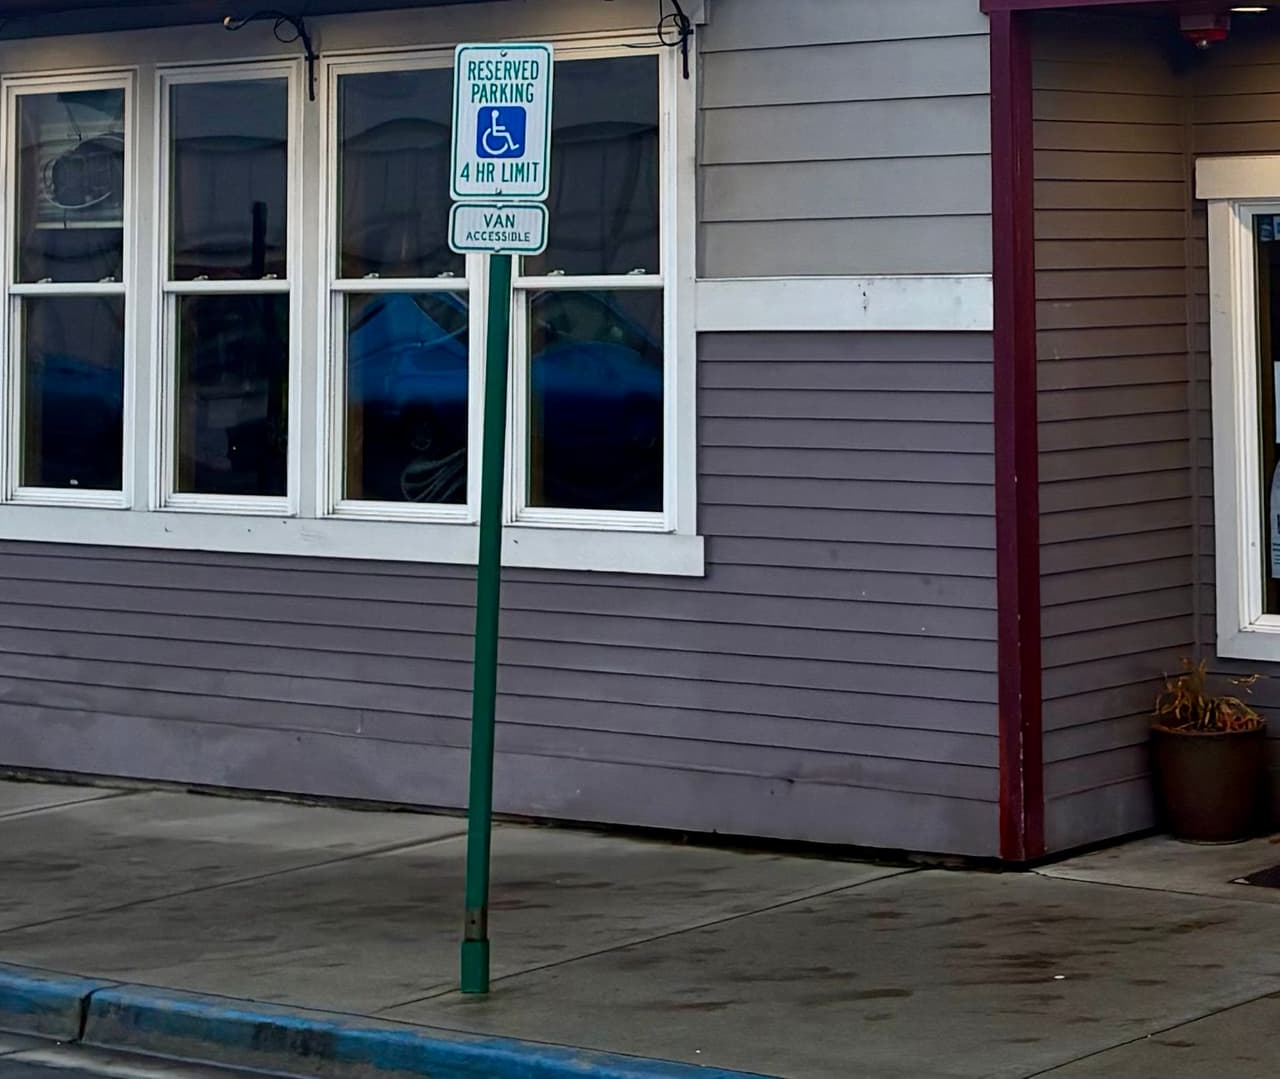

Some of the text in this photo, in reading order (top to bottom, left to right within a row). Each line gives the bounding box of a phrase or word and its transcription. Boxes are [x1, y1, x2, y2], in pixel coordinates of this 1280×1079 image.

[467, 60, 540, 82] RESERVED
[470, 82, 535, 104] PARKING
[459, 161, 540, 183] 4 HR LIMIT
[483, 213, 517, 229] VAN
[466, 231, 531, 243] ACCESSIBLE
